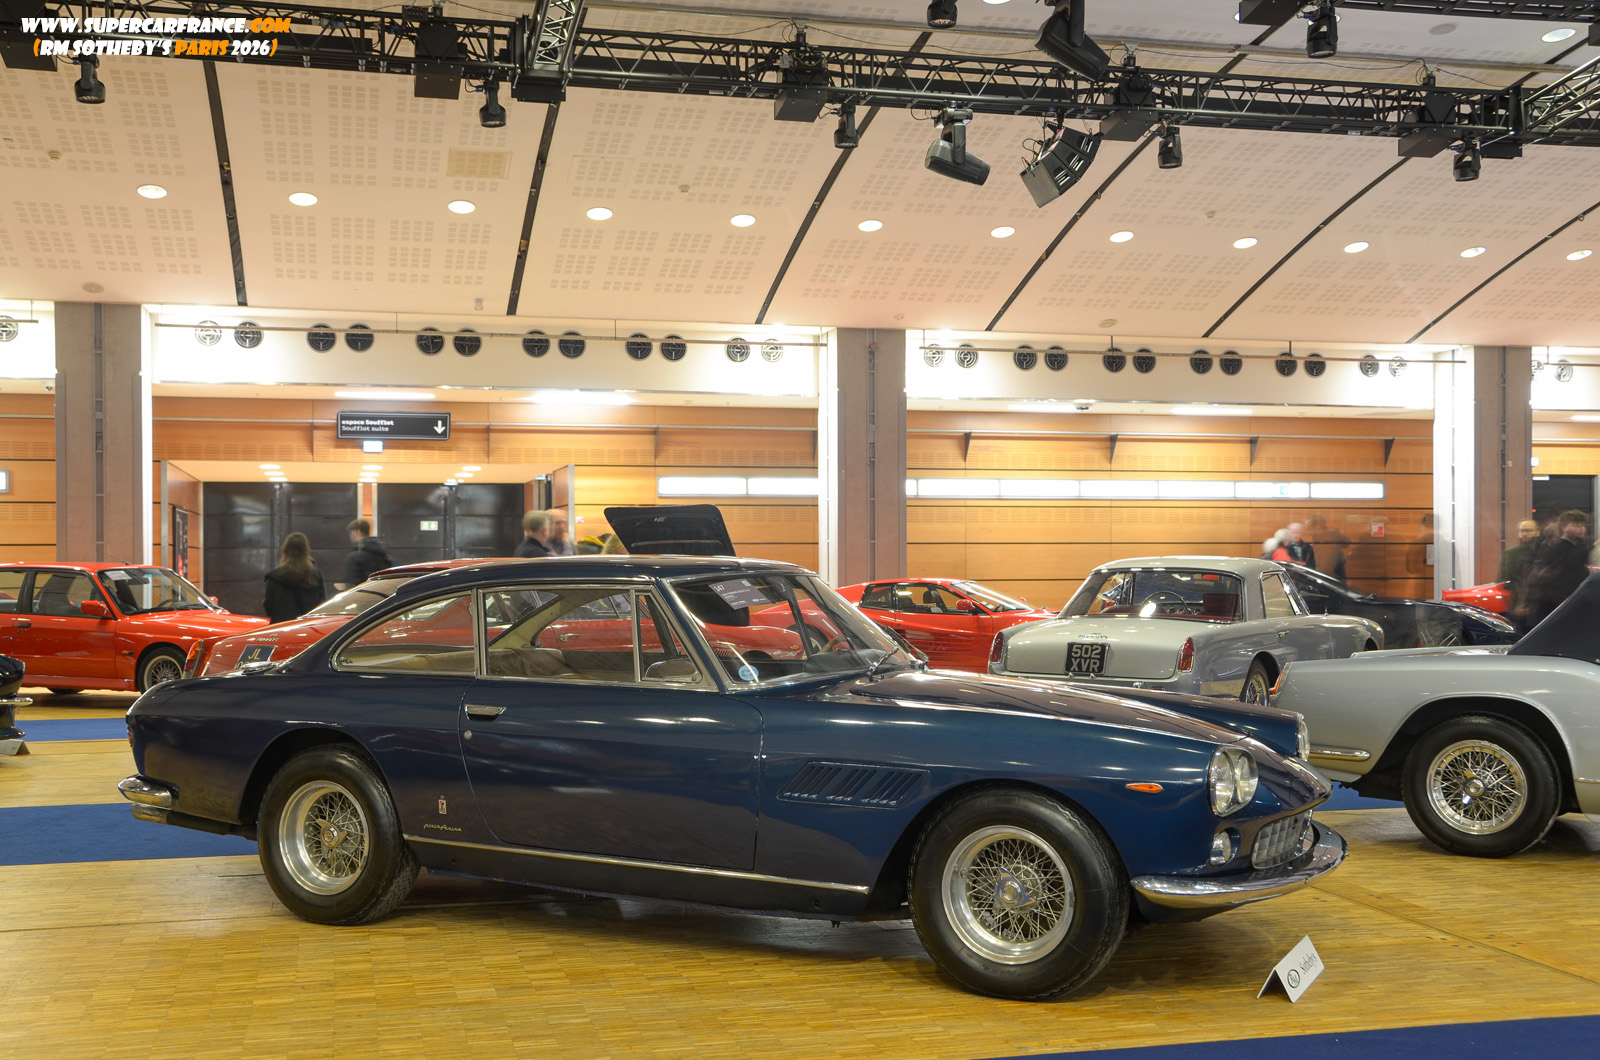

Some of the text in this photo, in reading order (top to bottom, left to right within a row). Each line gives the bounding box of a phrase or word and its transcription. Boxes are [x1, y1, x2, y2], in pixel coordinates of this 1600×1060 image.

[248, 648, 261, 660] JL
[1071, 644, 1102, 658] 502
[1070, 658, 1099, 672] XVR
